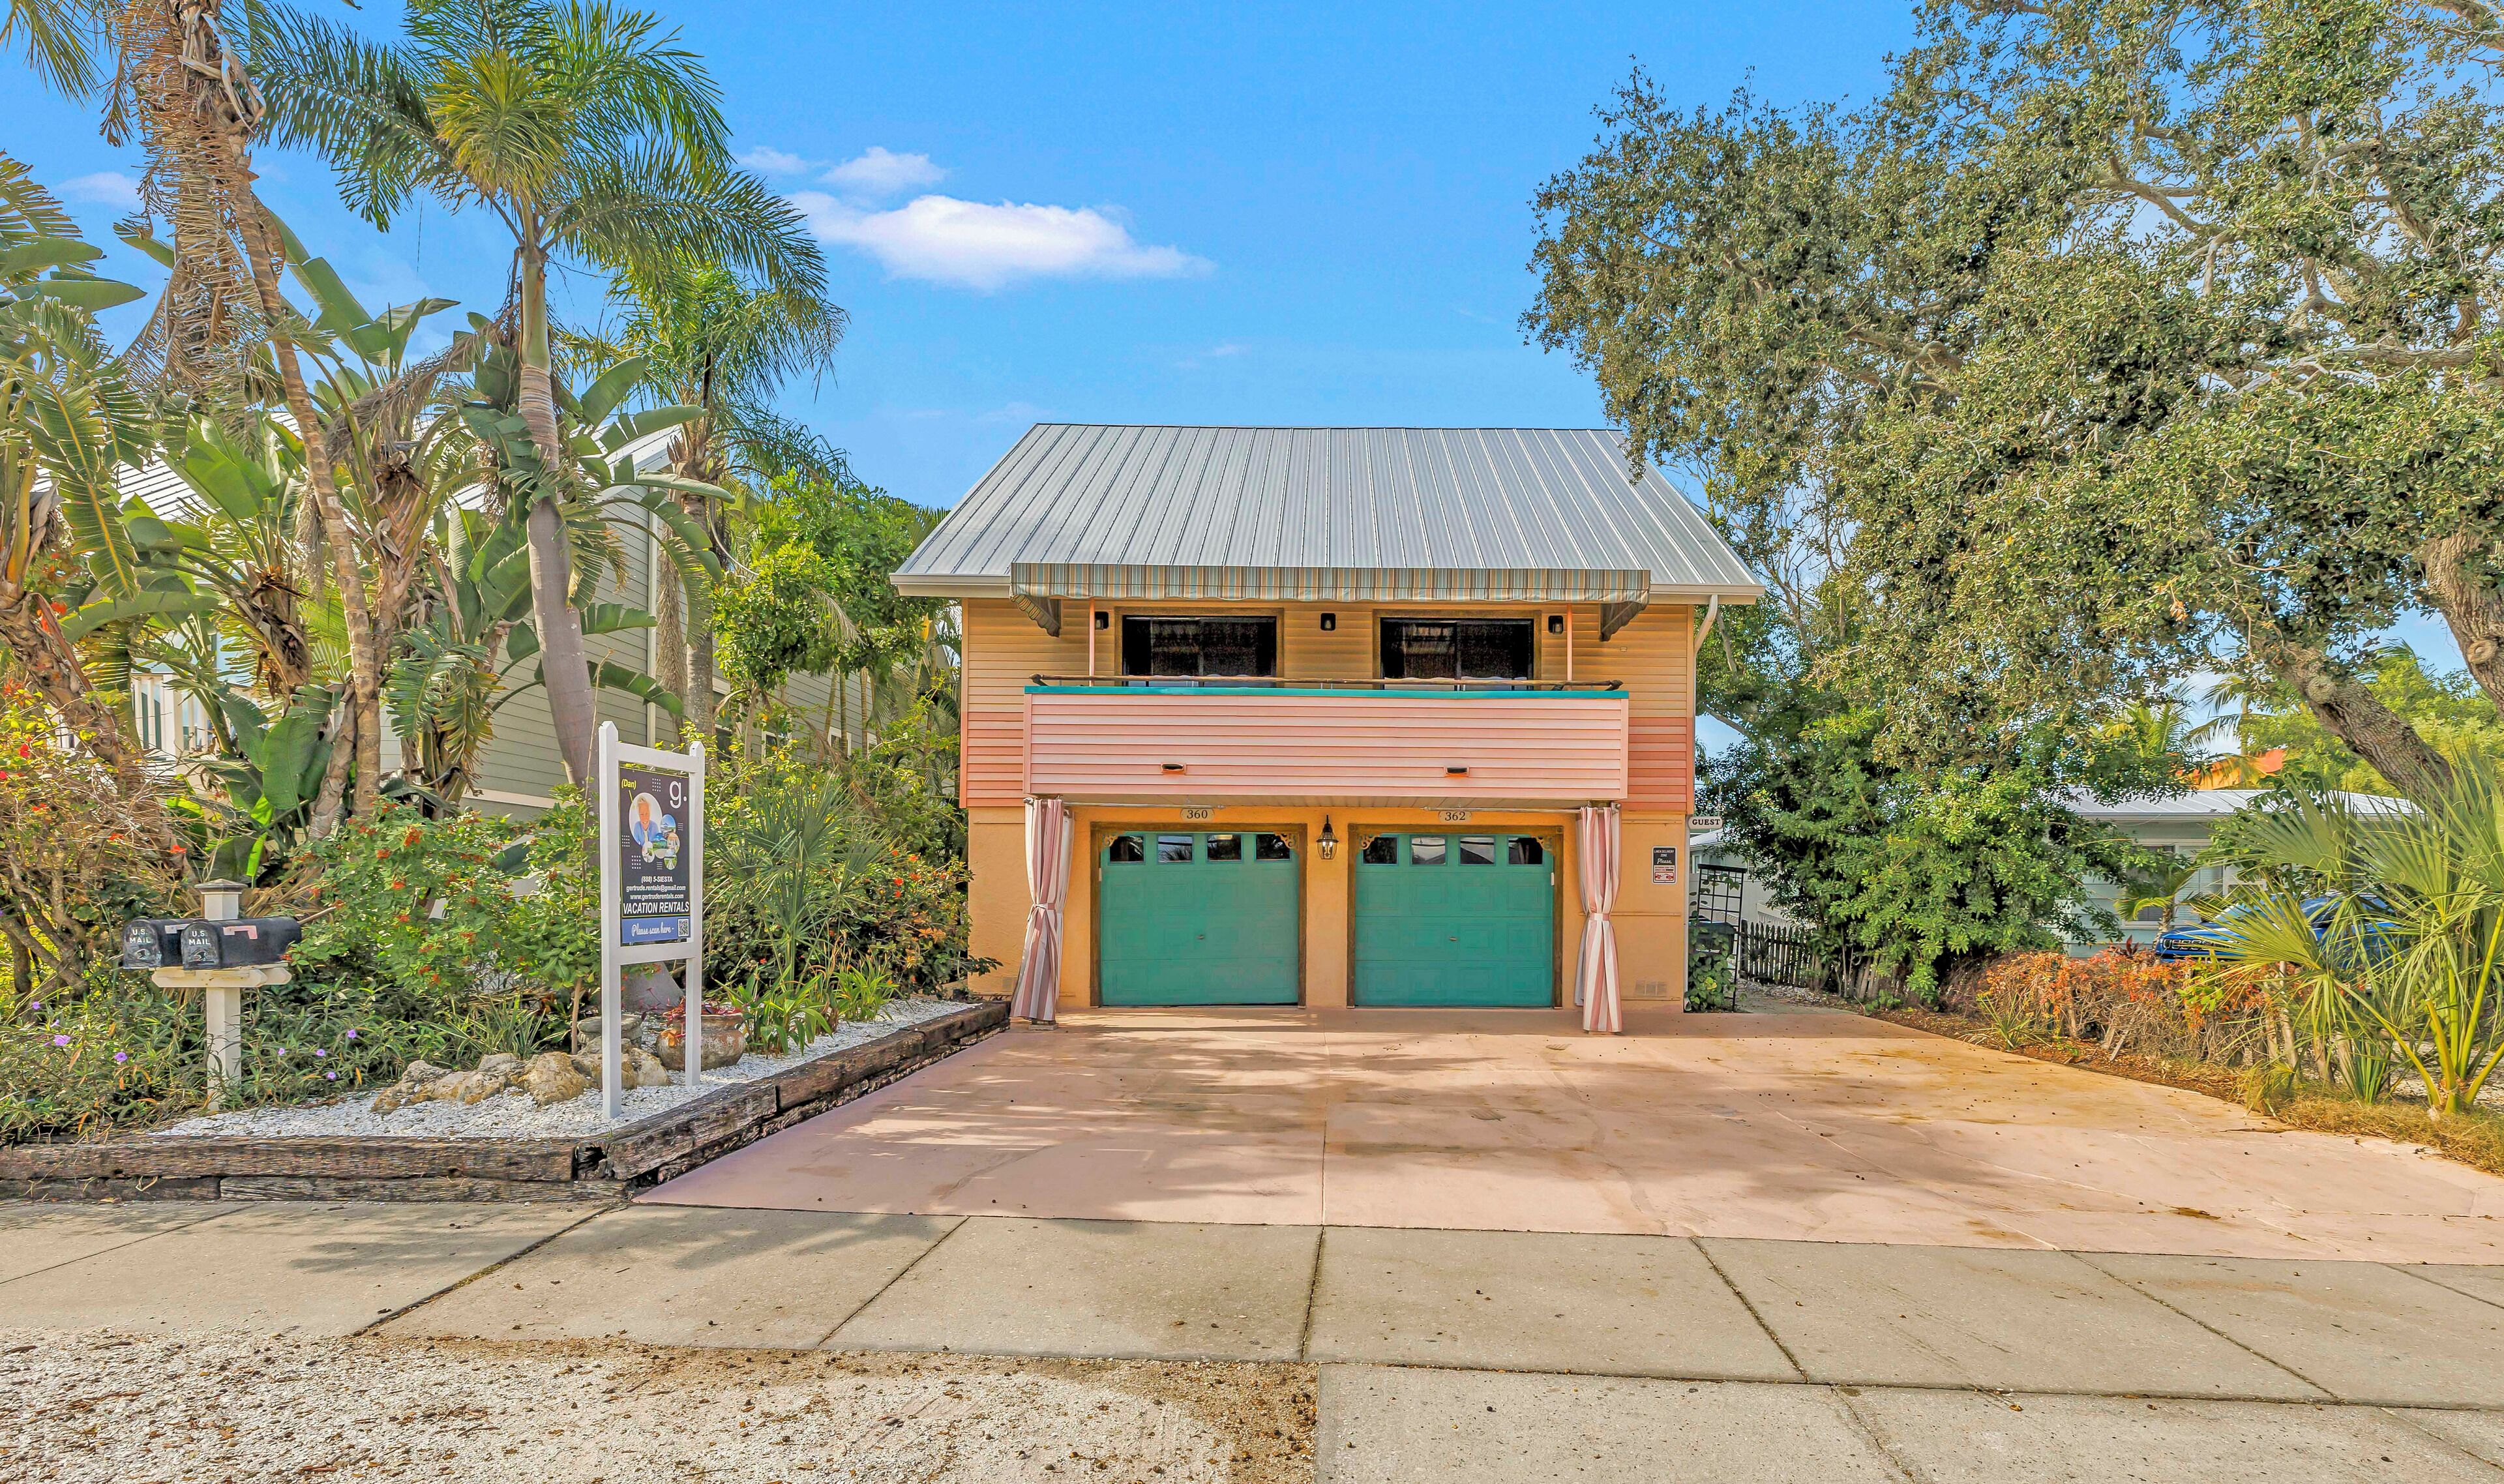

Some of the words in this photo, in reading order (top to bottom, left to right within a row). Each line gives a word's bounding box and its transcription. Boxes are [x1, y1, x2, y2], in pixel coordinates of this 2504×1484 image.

[621, 779, 636, 790] (Dan)
[669, 780, 687, 809] g.
[1187, 809, 1208, 819] 360
[1445, 811, 1466, 821] 362
[626, 884, 686, 893] gertrude.rentals@gmail.com
[623, 902, 658, 914] VACATION
[659, 901, 689, 913] RENTALS
[631, 923, 649, 937] Please
[661, 921, 672, 933] here
